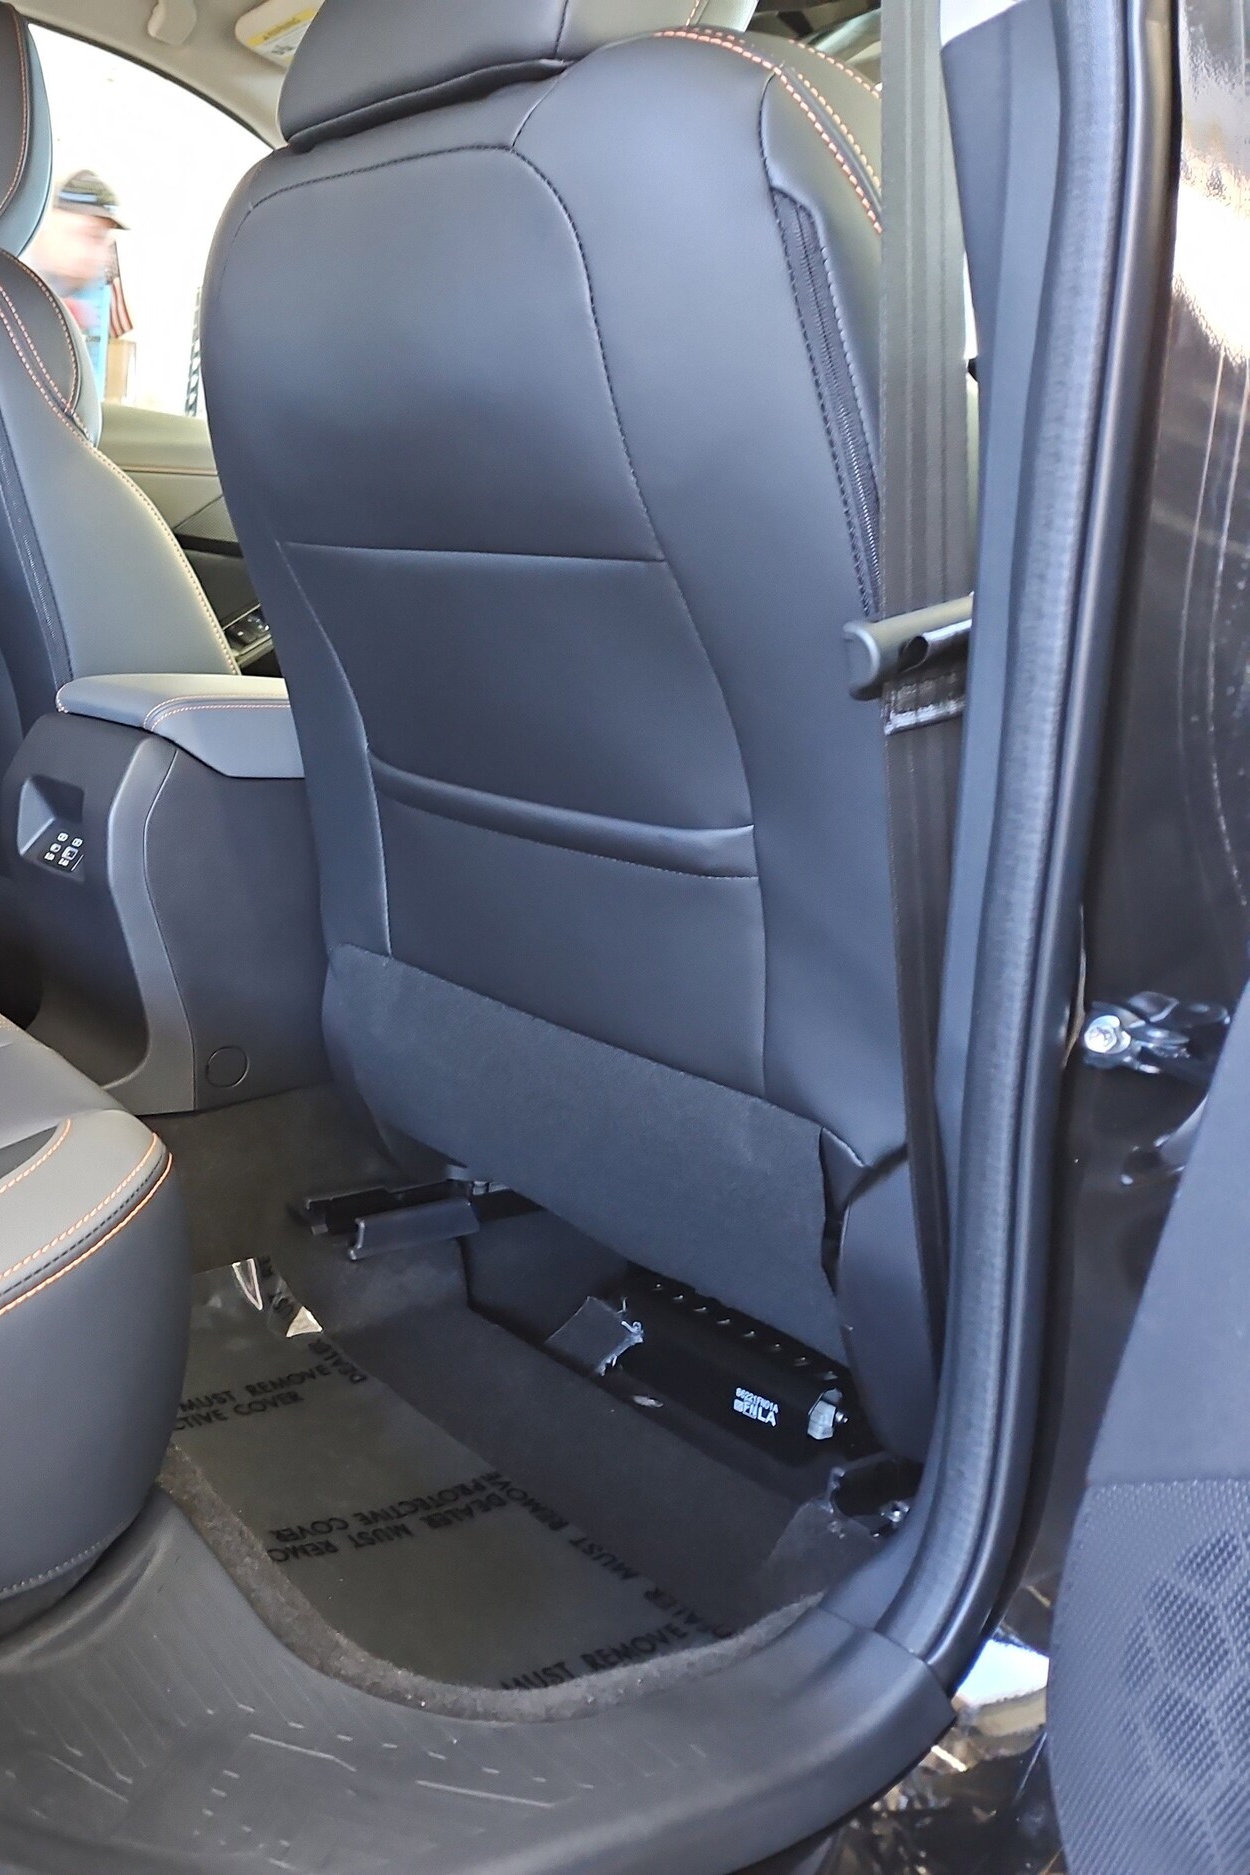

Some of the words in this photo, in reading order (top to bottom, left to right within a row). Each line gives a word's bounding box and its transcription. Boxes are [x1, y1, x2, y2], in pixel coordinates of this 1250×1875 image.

[178, 1390, 237, 1413] MUST
[245, 1364, 332, 1397] REMOVE
[173, 1409, 229, 1431] CTIVE
[234, 1390, 305, 1416] COVER
[353, 1477, 486, 1527] PROTECTIVE
[421, 1492, 507, 1530] DEALER
[268, 1516, 349, 1543] COVER
[347, 1523, 414, 1549] MUST
[267, 1540, 340, 1563] REMO
[569, 1536, 640, 1581] MUST
[580, 1622, 689, 1672] REMOVE
